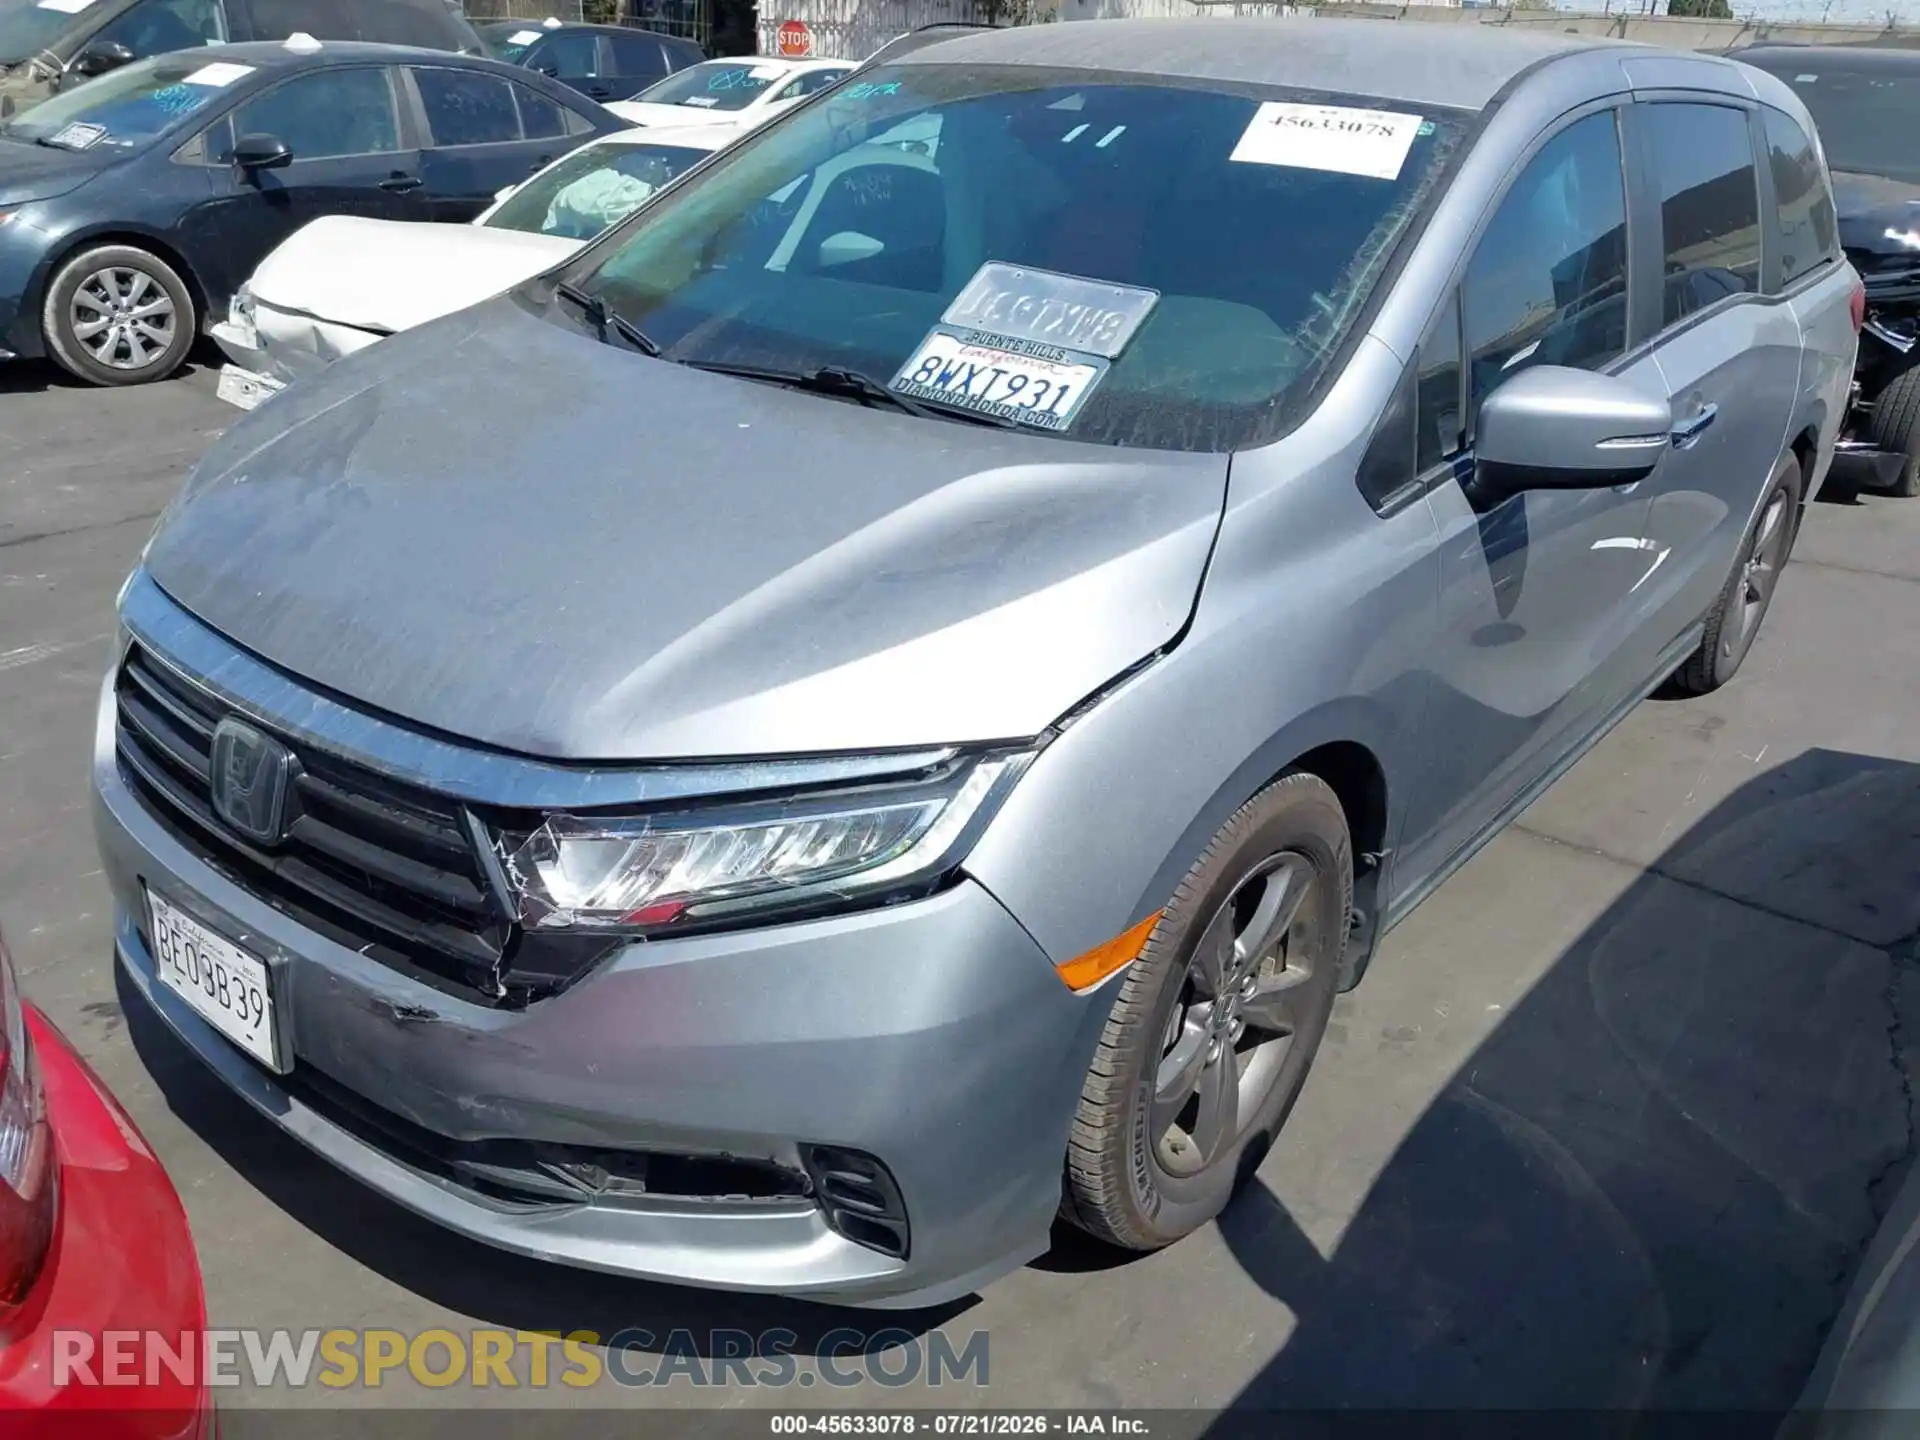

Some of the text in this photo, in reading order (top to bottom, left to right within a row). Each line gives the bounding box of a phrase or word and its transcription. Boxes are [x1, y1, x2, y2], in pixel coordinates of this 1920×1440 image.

[779, 31, 809, 46] STOP
[1268, 115, 1396, 137] 45633078
[971, 331, 1066, 362] PUENTE HILLS
[911, 355, 1071, 416] 8WXT931
[1133, 1086, 1151, 1191] MICHELIN
